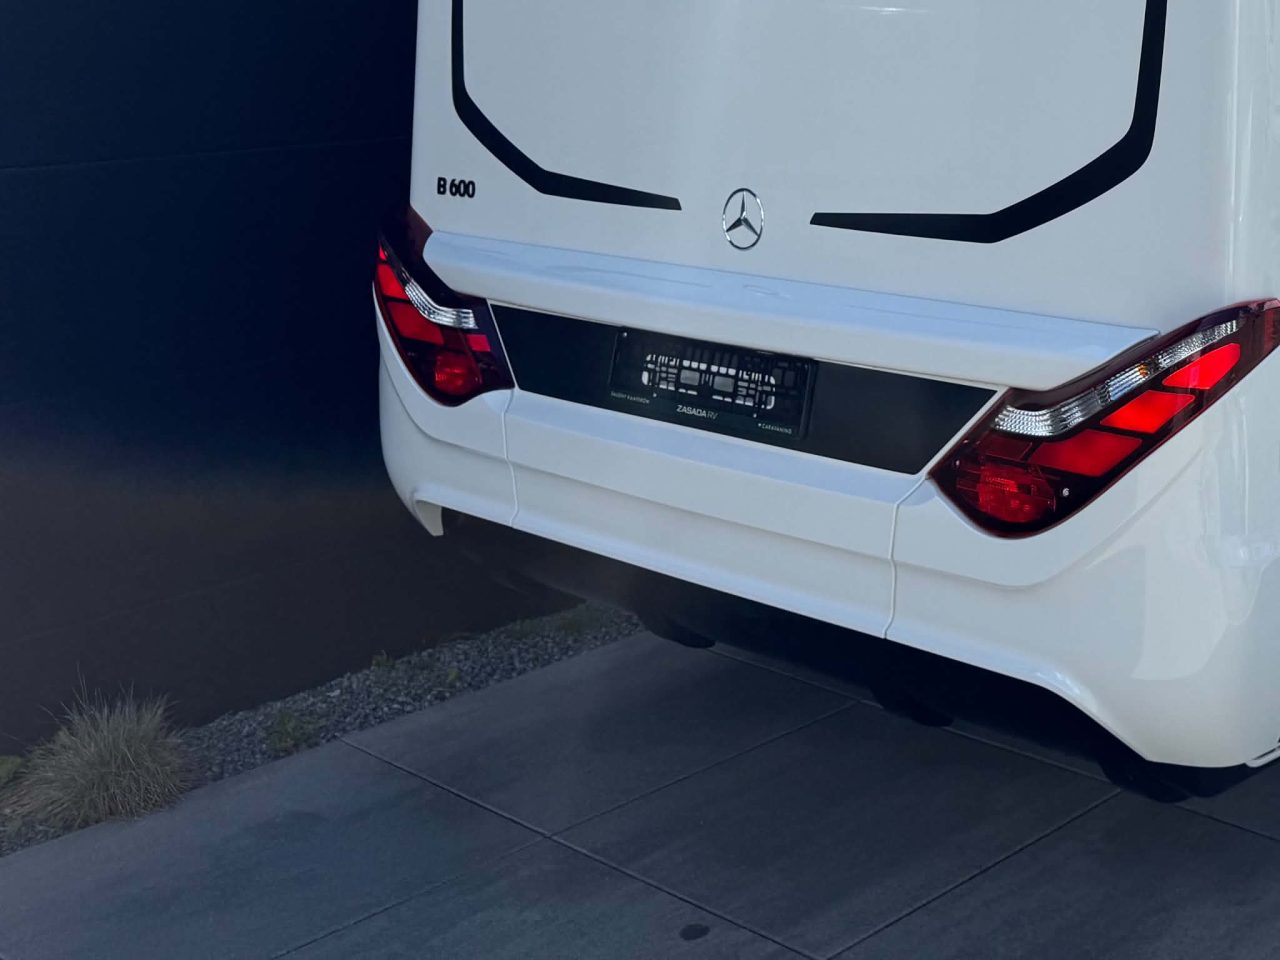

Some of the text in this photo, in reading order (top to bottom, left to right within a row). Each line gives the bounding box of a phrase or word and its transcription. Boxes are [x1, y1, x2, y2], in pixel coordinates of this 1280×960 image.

[437, 176, 476, 198] B 600
[676, 404, 707, 419] ZASADA
